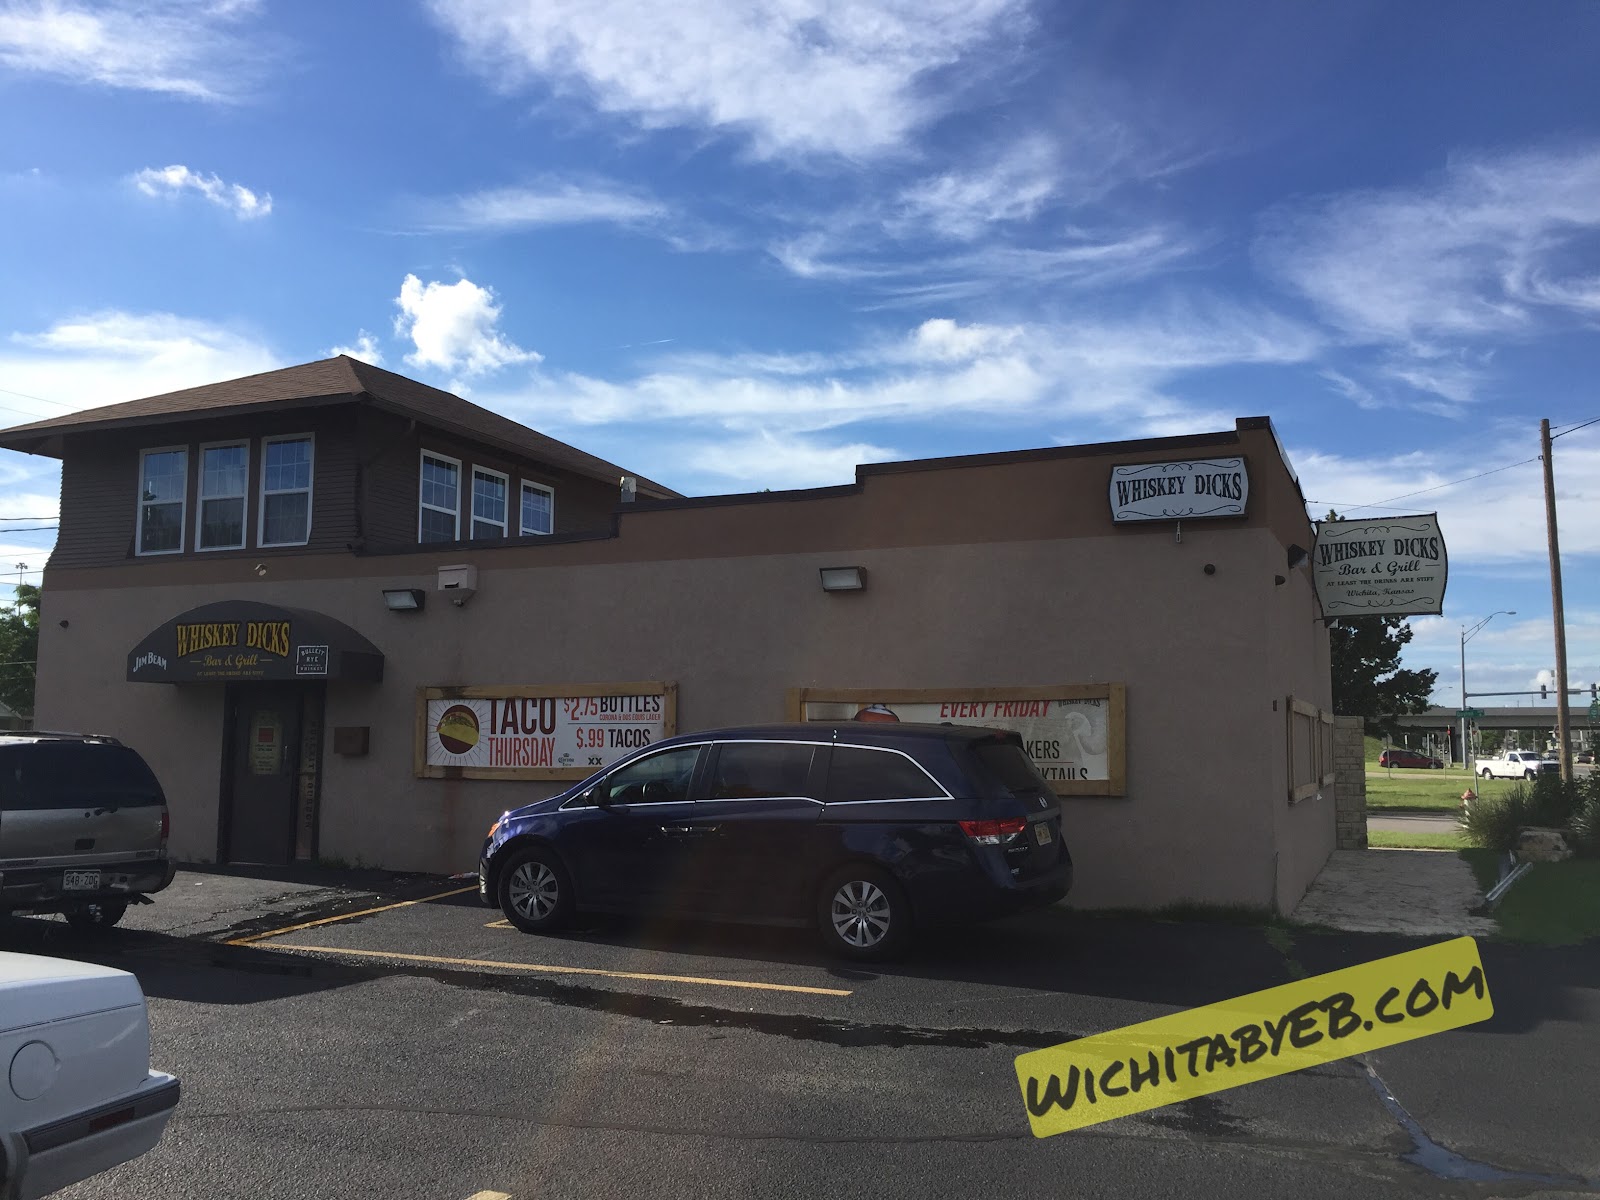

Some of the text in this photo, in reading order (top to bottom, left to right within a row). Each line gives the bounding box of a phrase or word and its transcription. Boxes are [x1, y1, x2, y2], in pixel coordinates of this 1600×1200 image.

[1116, 472, 1242, 507] WHISKEY DICKS
[1319, 537, 1439, 566] WHISKEY DICKS
[1338, 560, 1421, 576] Bar & Grill
[1346, 589, 1380, 597] Wichita,
[176, 621, 291, 658] WHISKEY DICKS
[133, 651, 168, 673] JIM BEAM
[203, 653, 258, 669] Bar & Grill
[600, 695, 660, 712] BOTTLES
[940, 700, 1051, 718] EVERY FRIDAY
[486, 697, 556, 734] TACO
[576, 727, 651, 749] $.99 TACOS
[488, 737, 555, 766] THURSDAY
[1026, 740, 1060, 759] KERS
